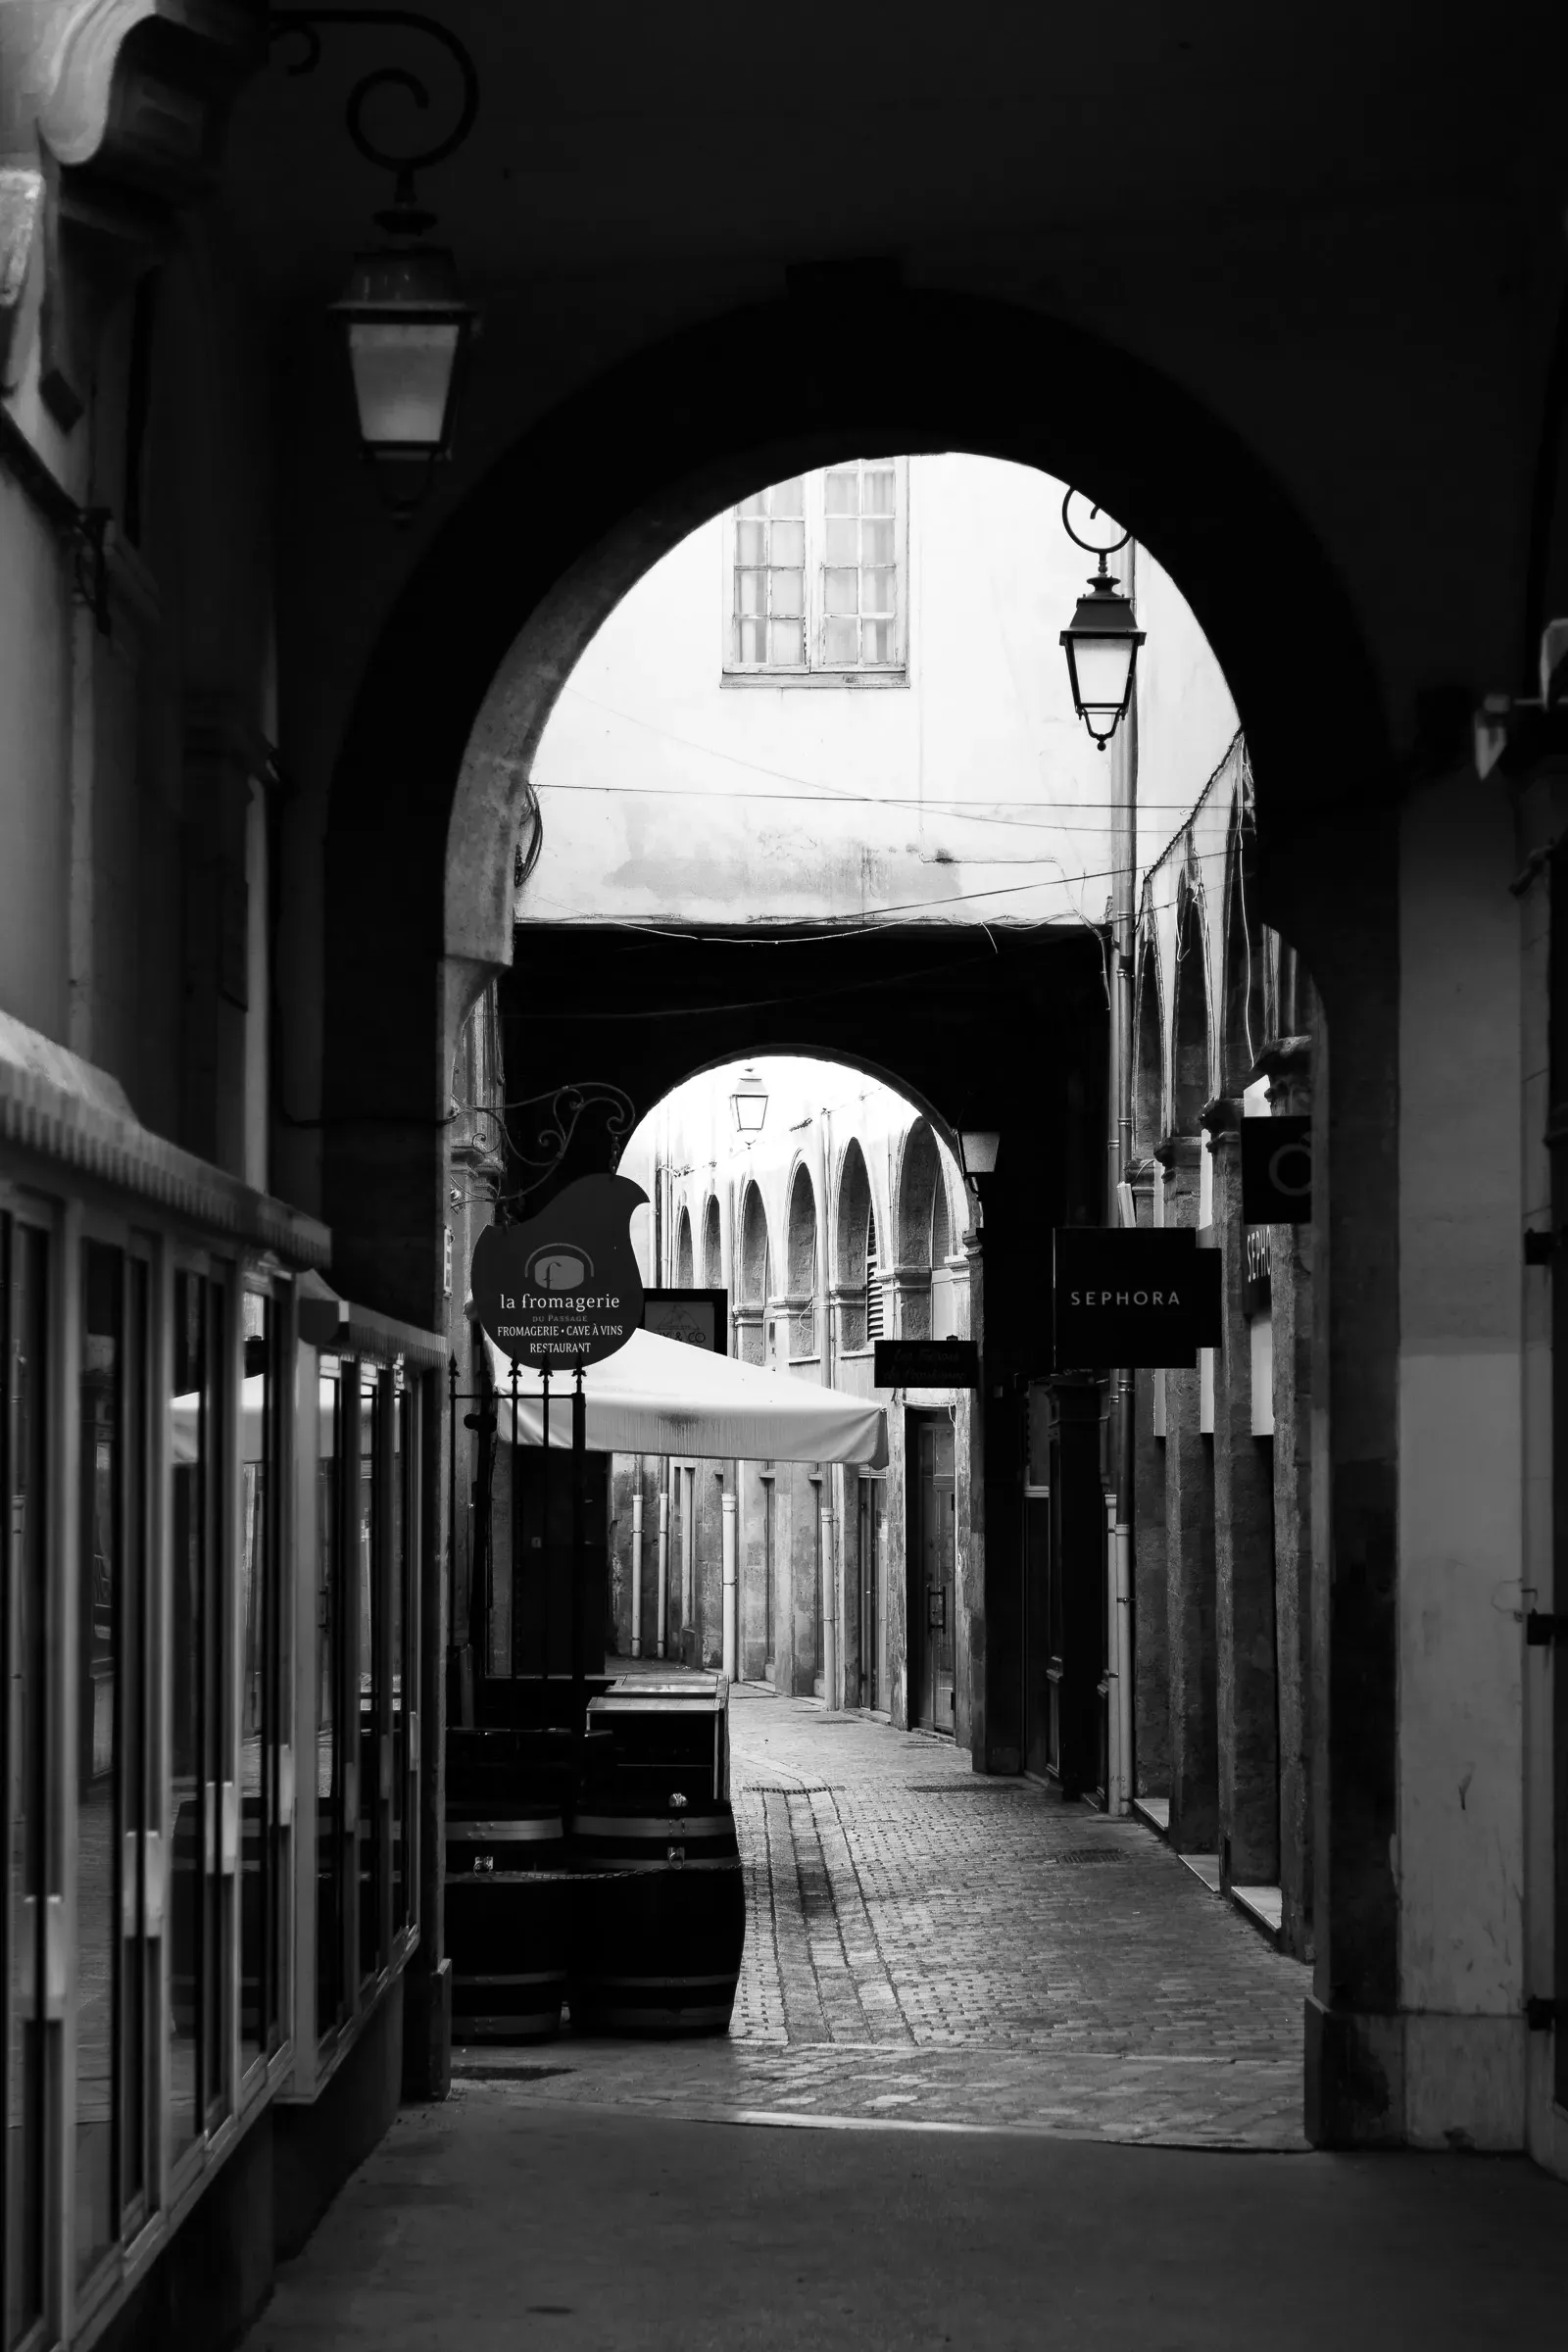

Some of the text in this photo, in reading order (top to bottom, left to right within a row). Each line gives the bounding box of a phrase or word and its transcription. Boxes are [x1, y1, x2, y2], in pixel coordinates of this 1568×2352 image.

[500, 1293, 620, 1312] la fromagerie
[1070, 1291, 1180, 1305] SEPHORA
[497, 1322, 623, 1337] FROMAGERIE CAVE À VINS
[688, 1332, 707, 1344] CO
[530, 1342, 592, 1353] RESTAURANT
